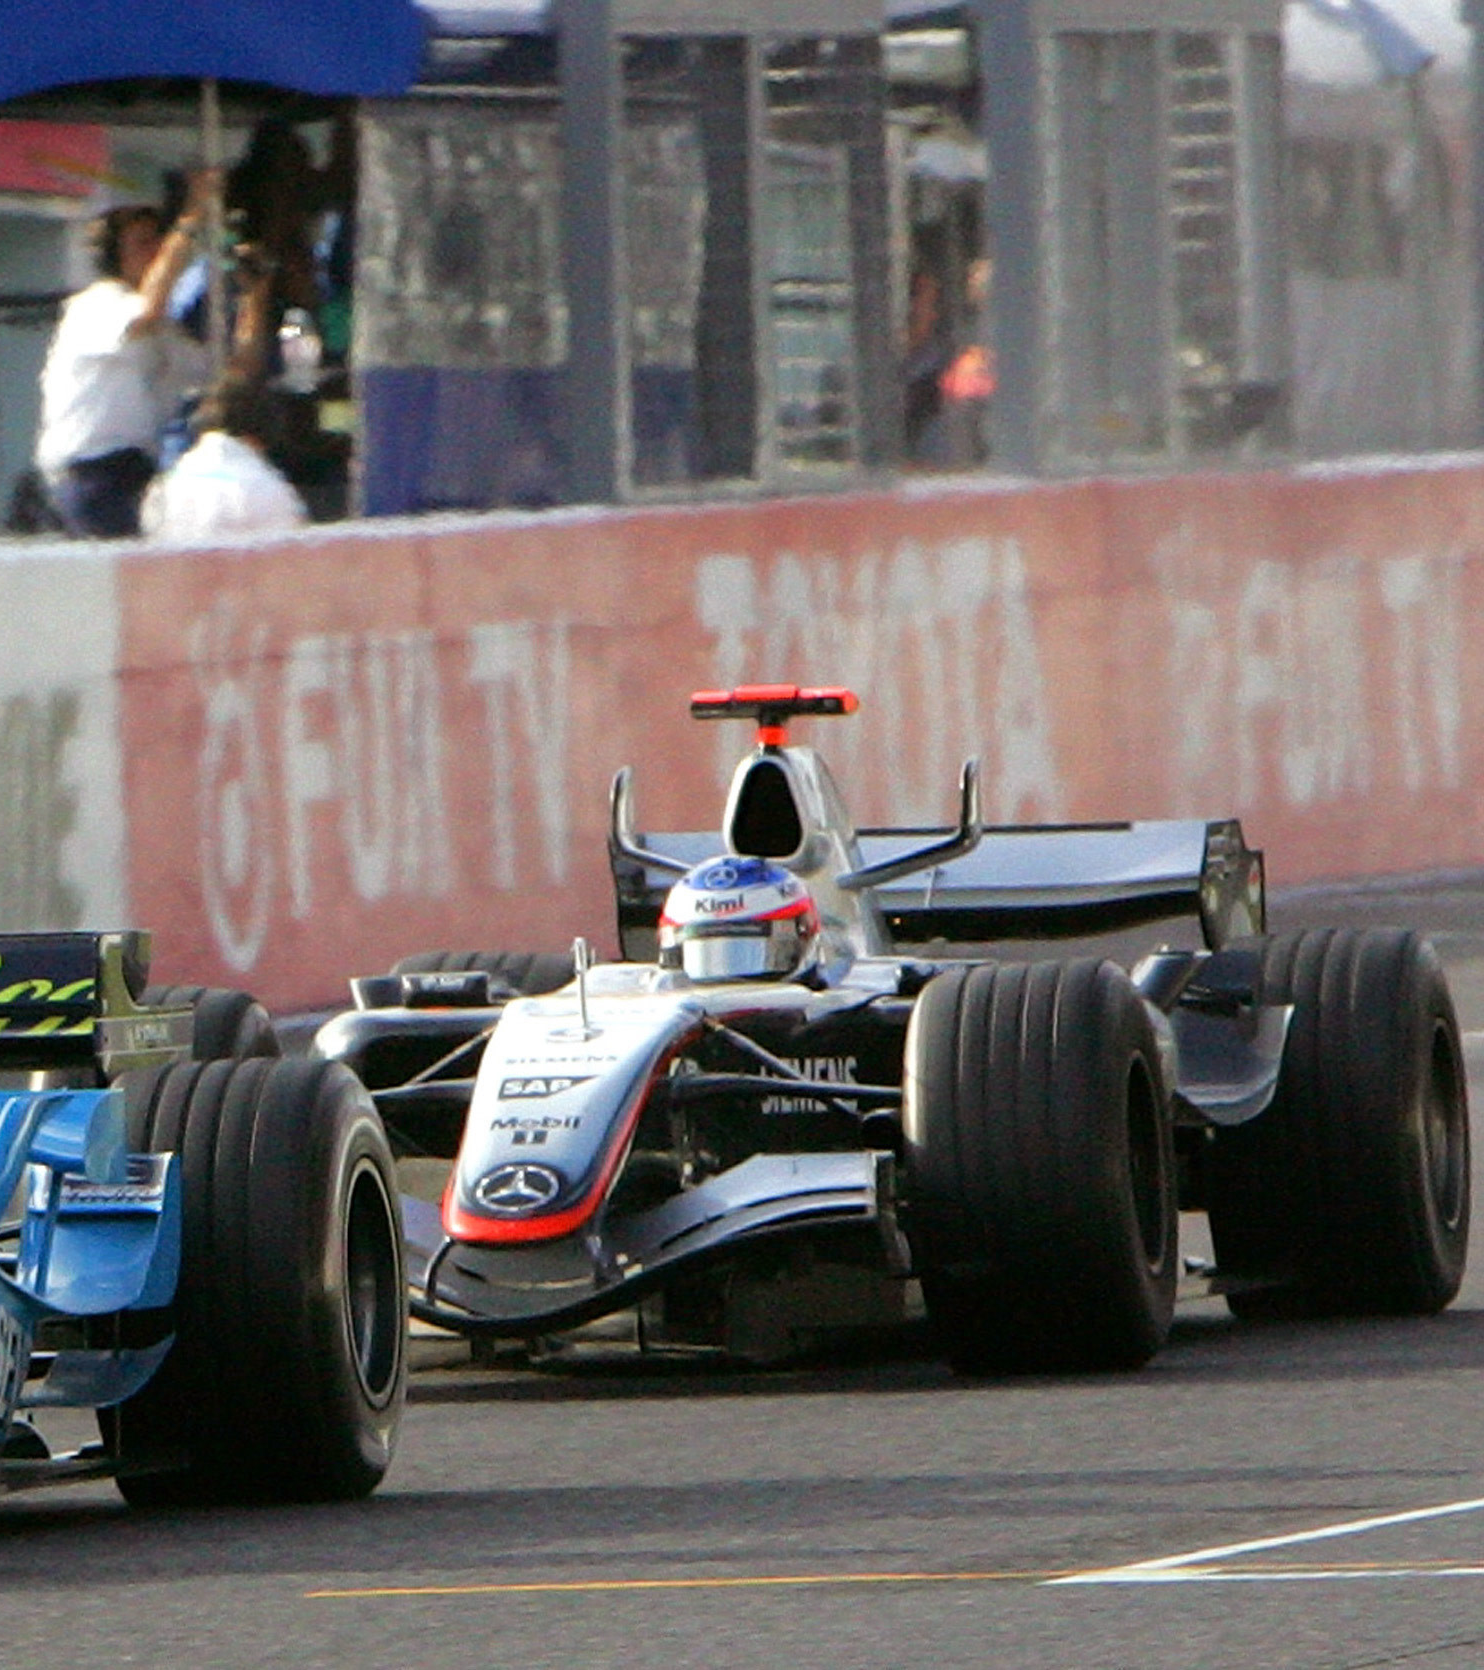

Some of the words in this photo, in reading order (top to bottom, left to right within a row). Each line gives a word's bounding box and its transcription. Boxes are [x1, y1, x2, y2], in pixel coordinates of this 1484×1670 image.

[282, 629, 457, 919] FUJI
[469, 614, 571, 892] TV
[695, 894, 745, 913] Kimi
[503, 1079, 574, 1097] SAP
[490, 1115, 581, 1131] Mobil
